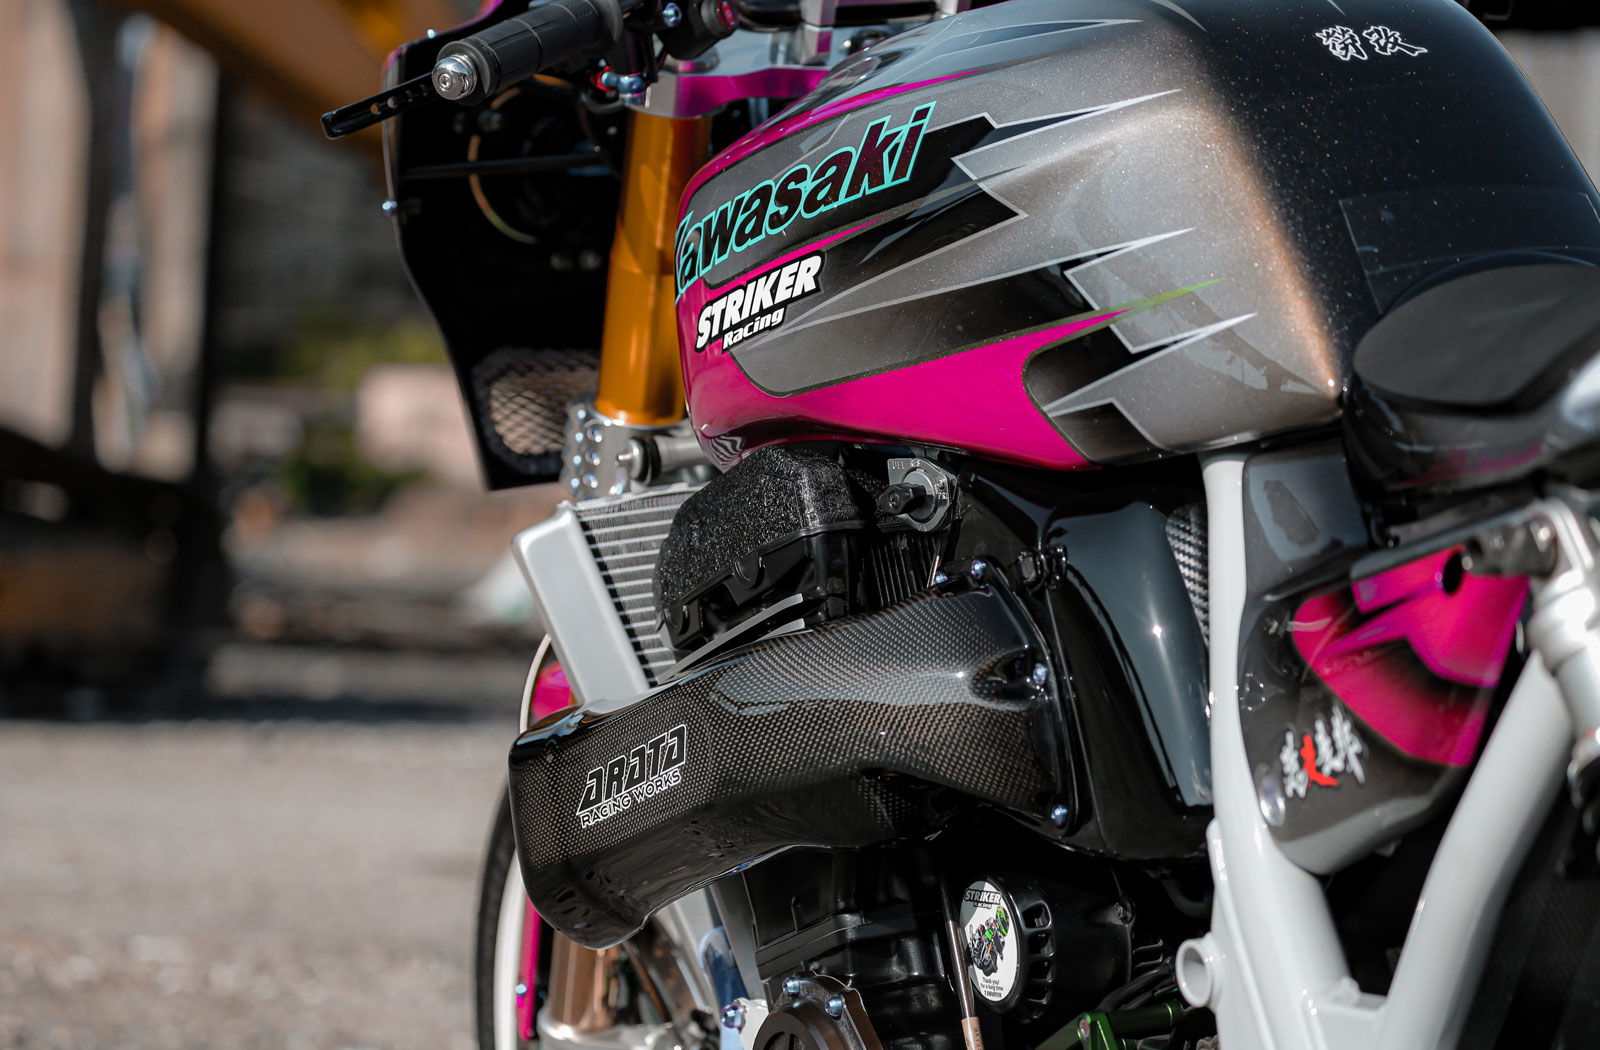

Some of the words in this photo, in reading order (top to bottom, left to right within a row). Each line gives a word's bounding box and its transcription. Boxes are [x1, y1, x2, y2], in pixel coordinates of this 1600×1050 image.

[696, 254, 823, 349] STRIKER
[723, 307, 784, 349] Racing
[576, 724, 686, 815] ARATA
[580, 793, 631, 828] RACING
[632, 768, 681, 803] WORKS
[965, 889, 1001, 904] STRIKER
